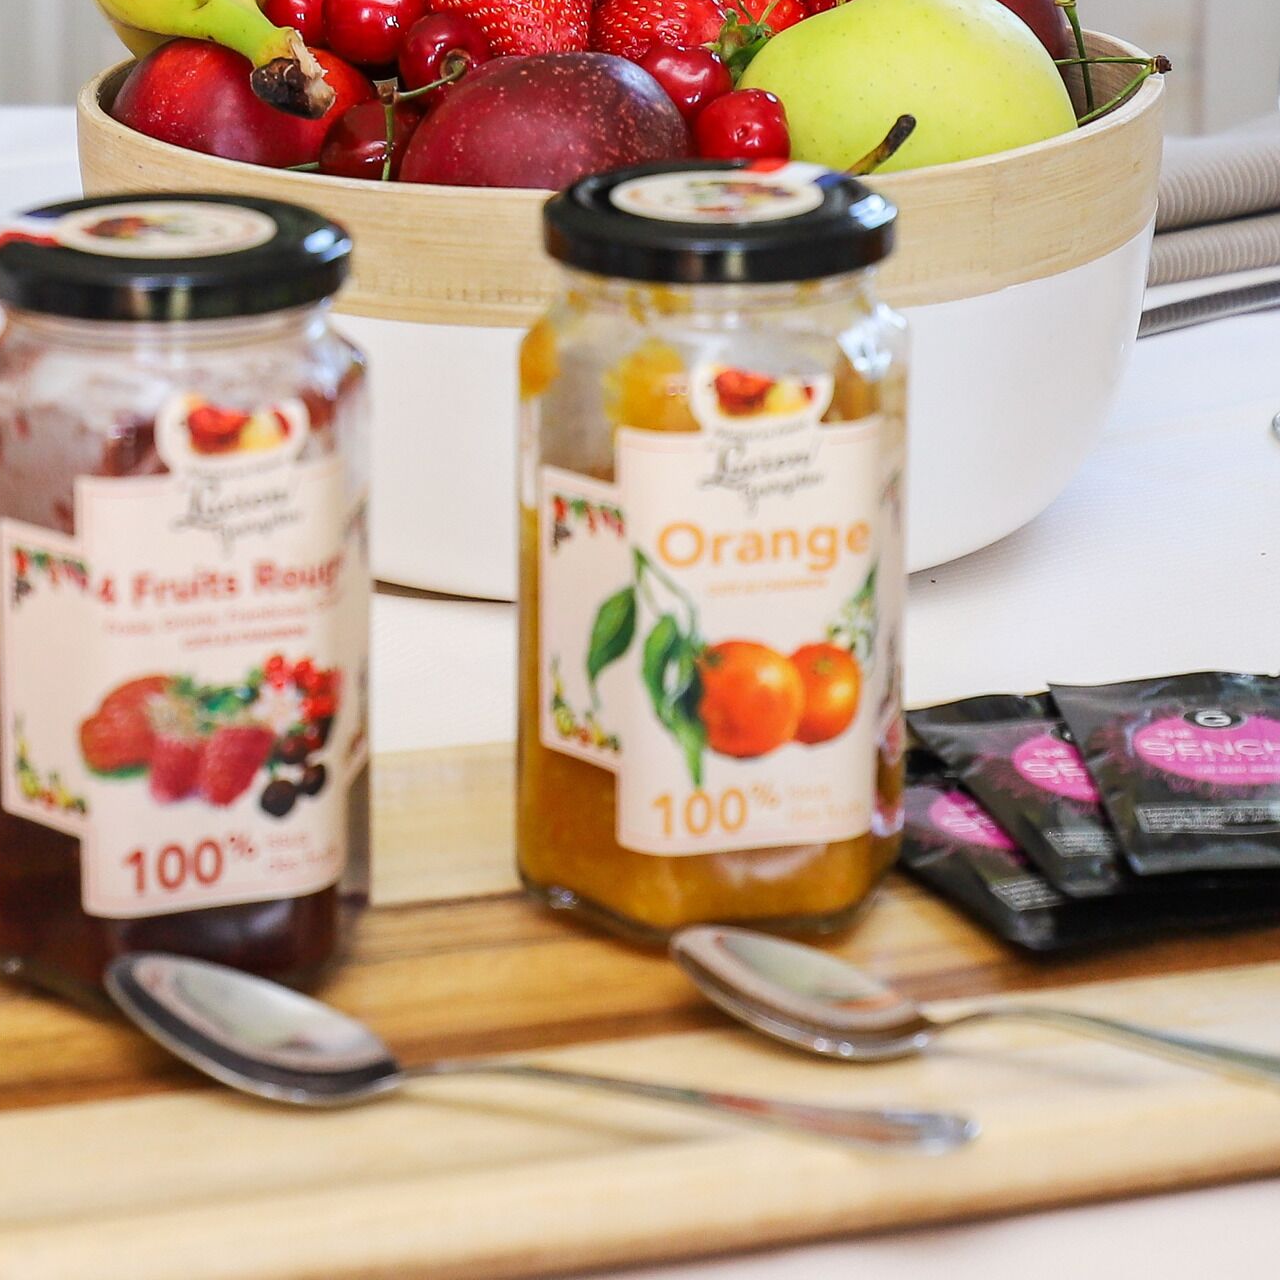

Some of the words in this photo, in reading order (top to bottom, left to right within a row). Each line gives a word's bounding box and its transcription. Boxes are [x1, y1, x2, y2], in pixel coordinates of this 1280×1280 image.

[656, 519, 871, 573] Orange
[130, 567, 240, 607] Fruits
[123, 831, 258, 896] 100%
